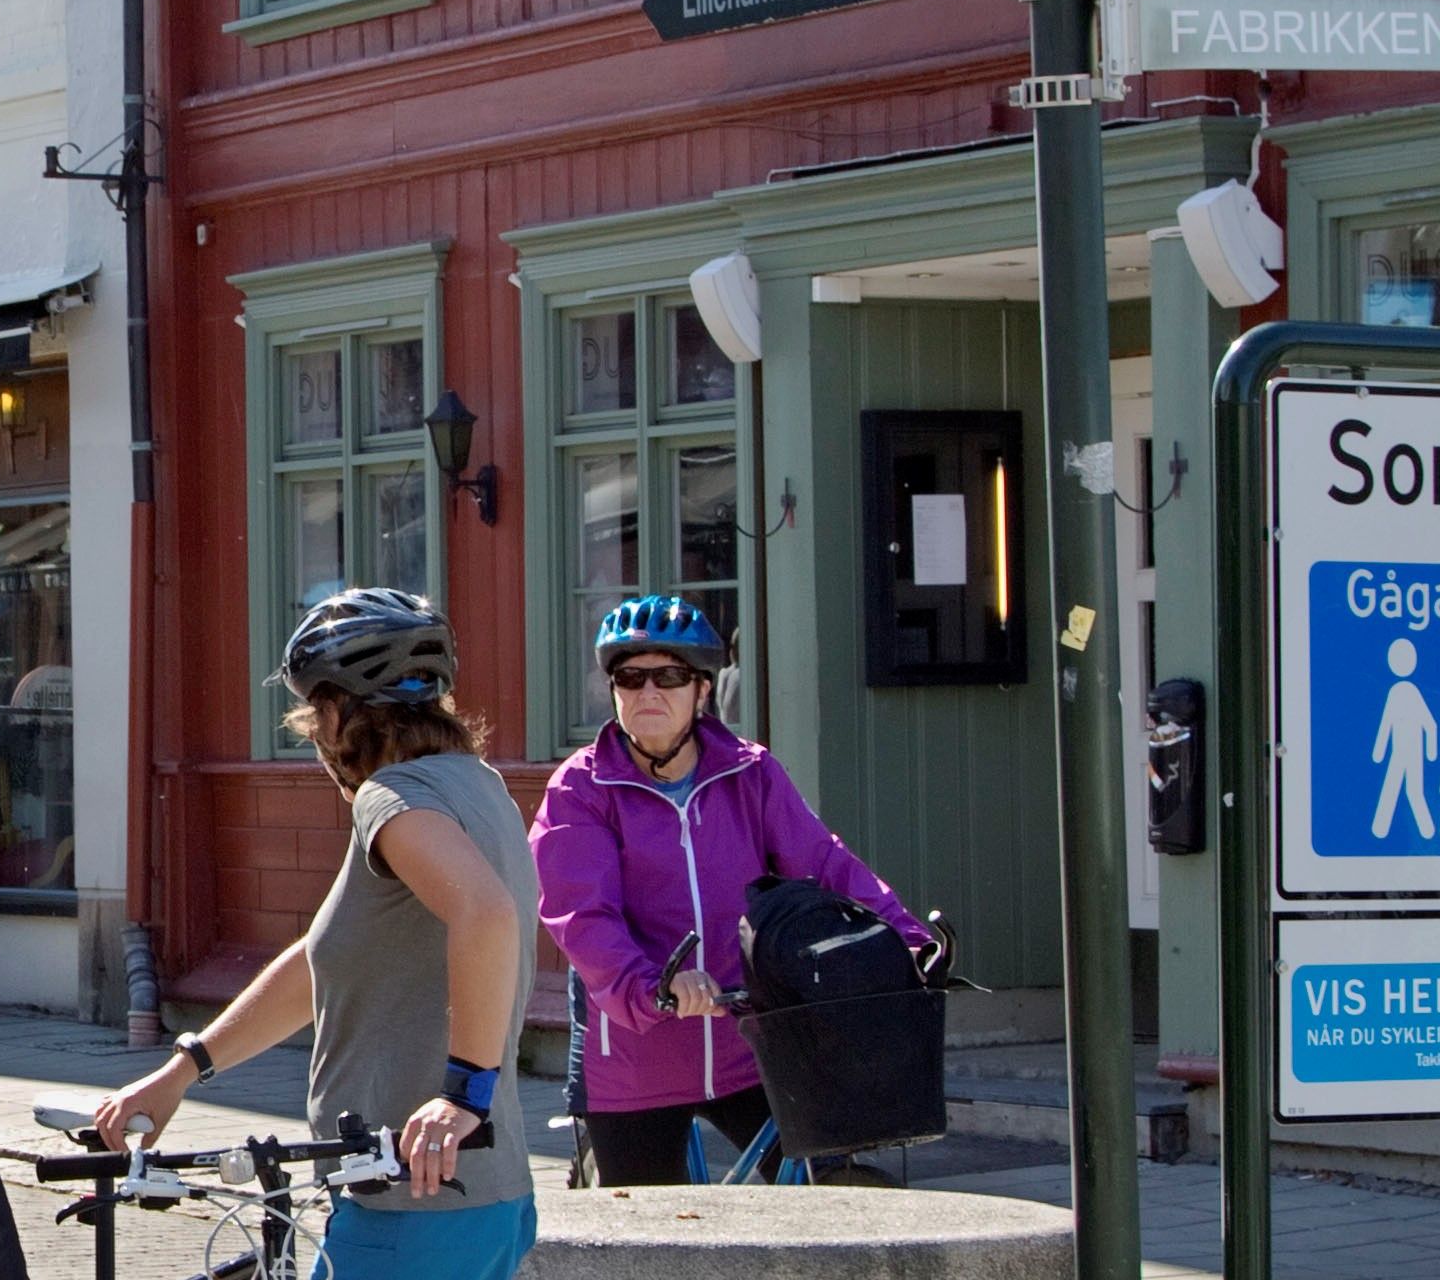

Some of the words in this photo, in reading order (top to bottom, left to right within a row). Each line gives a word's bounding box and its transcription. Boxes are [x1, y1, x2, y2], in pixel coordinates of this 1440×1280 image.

[1305, 978, 1367, 1016] VIS
[1306, 1023, 1345, 1046] NÅR
[1351, 1027, 1376, 1046] DU
